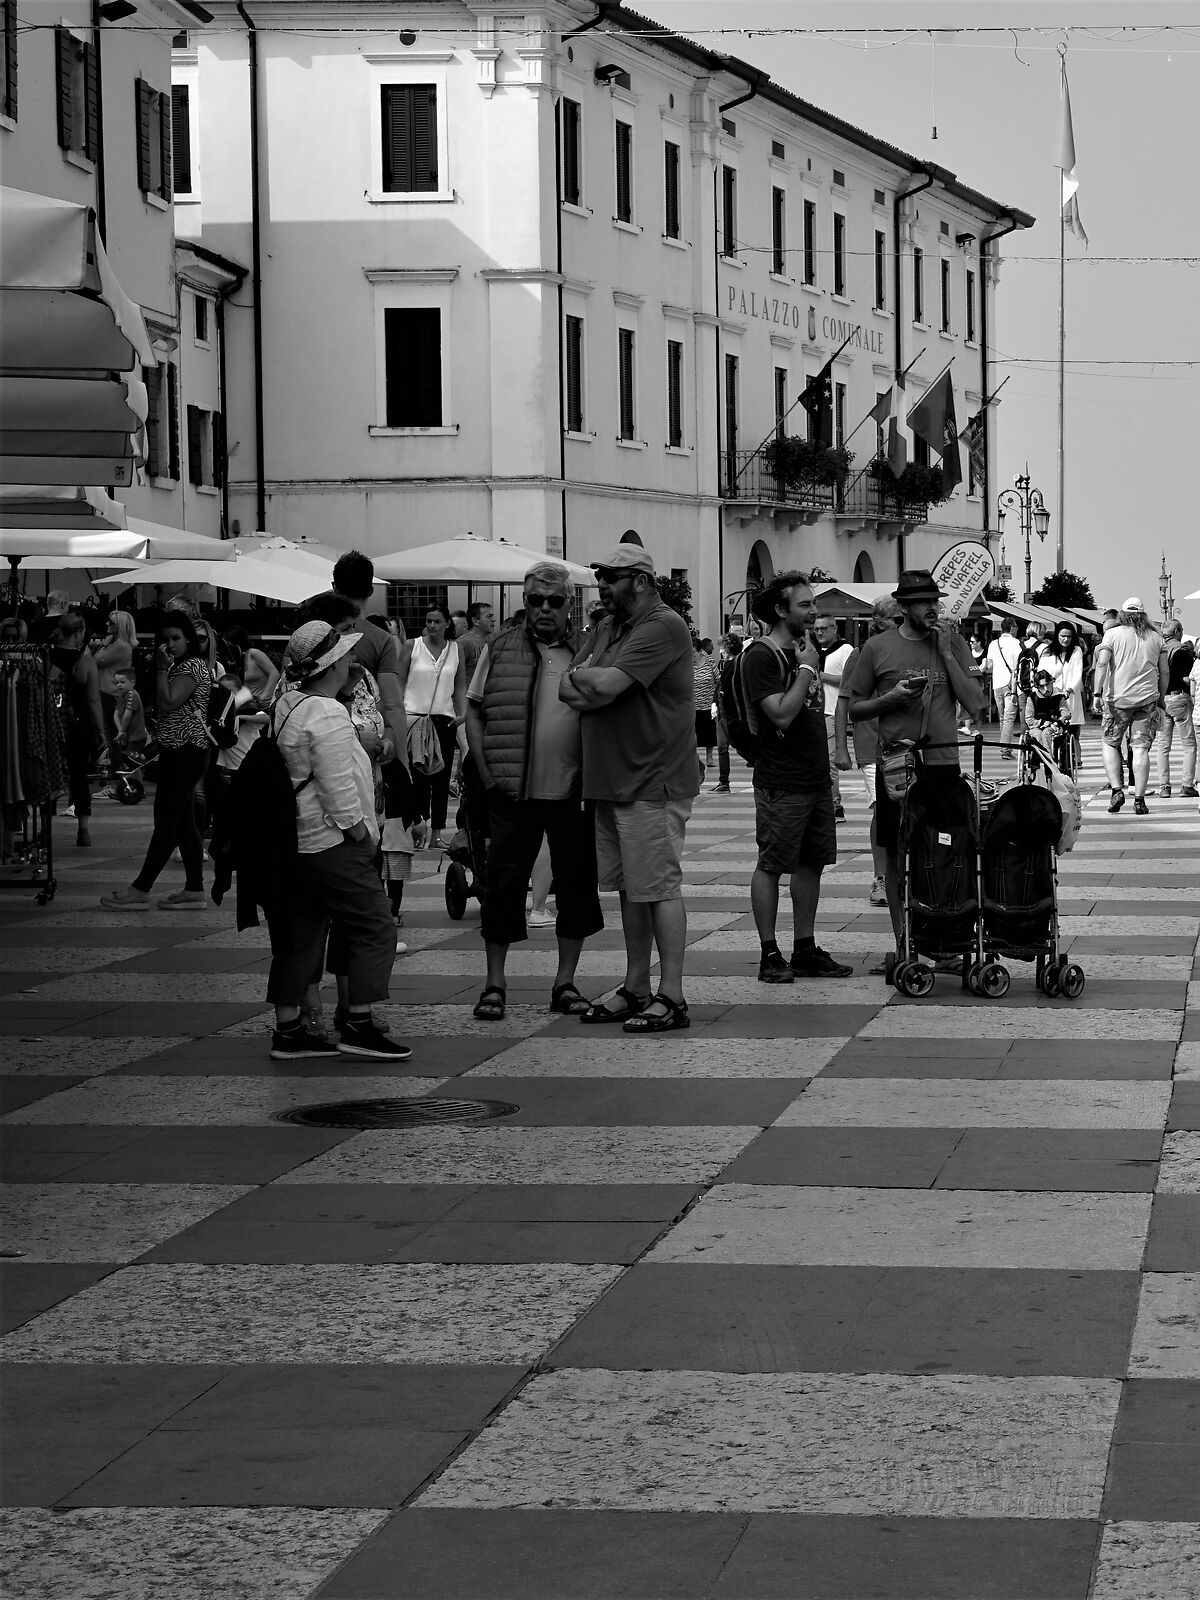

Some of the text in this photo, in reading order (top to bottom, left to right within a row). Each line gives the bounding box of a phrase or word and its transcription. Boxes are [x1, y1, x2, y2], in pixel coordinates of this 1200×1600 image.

[728, 285, 884, 355] PALAZZO COMUNALE
[936, 549, 967, 589] CRÊPES
[950, 552, 983, 590] WAFFEL
[951, 561, 990, 614] con NUTELLA
